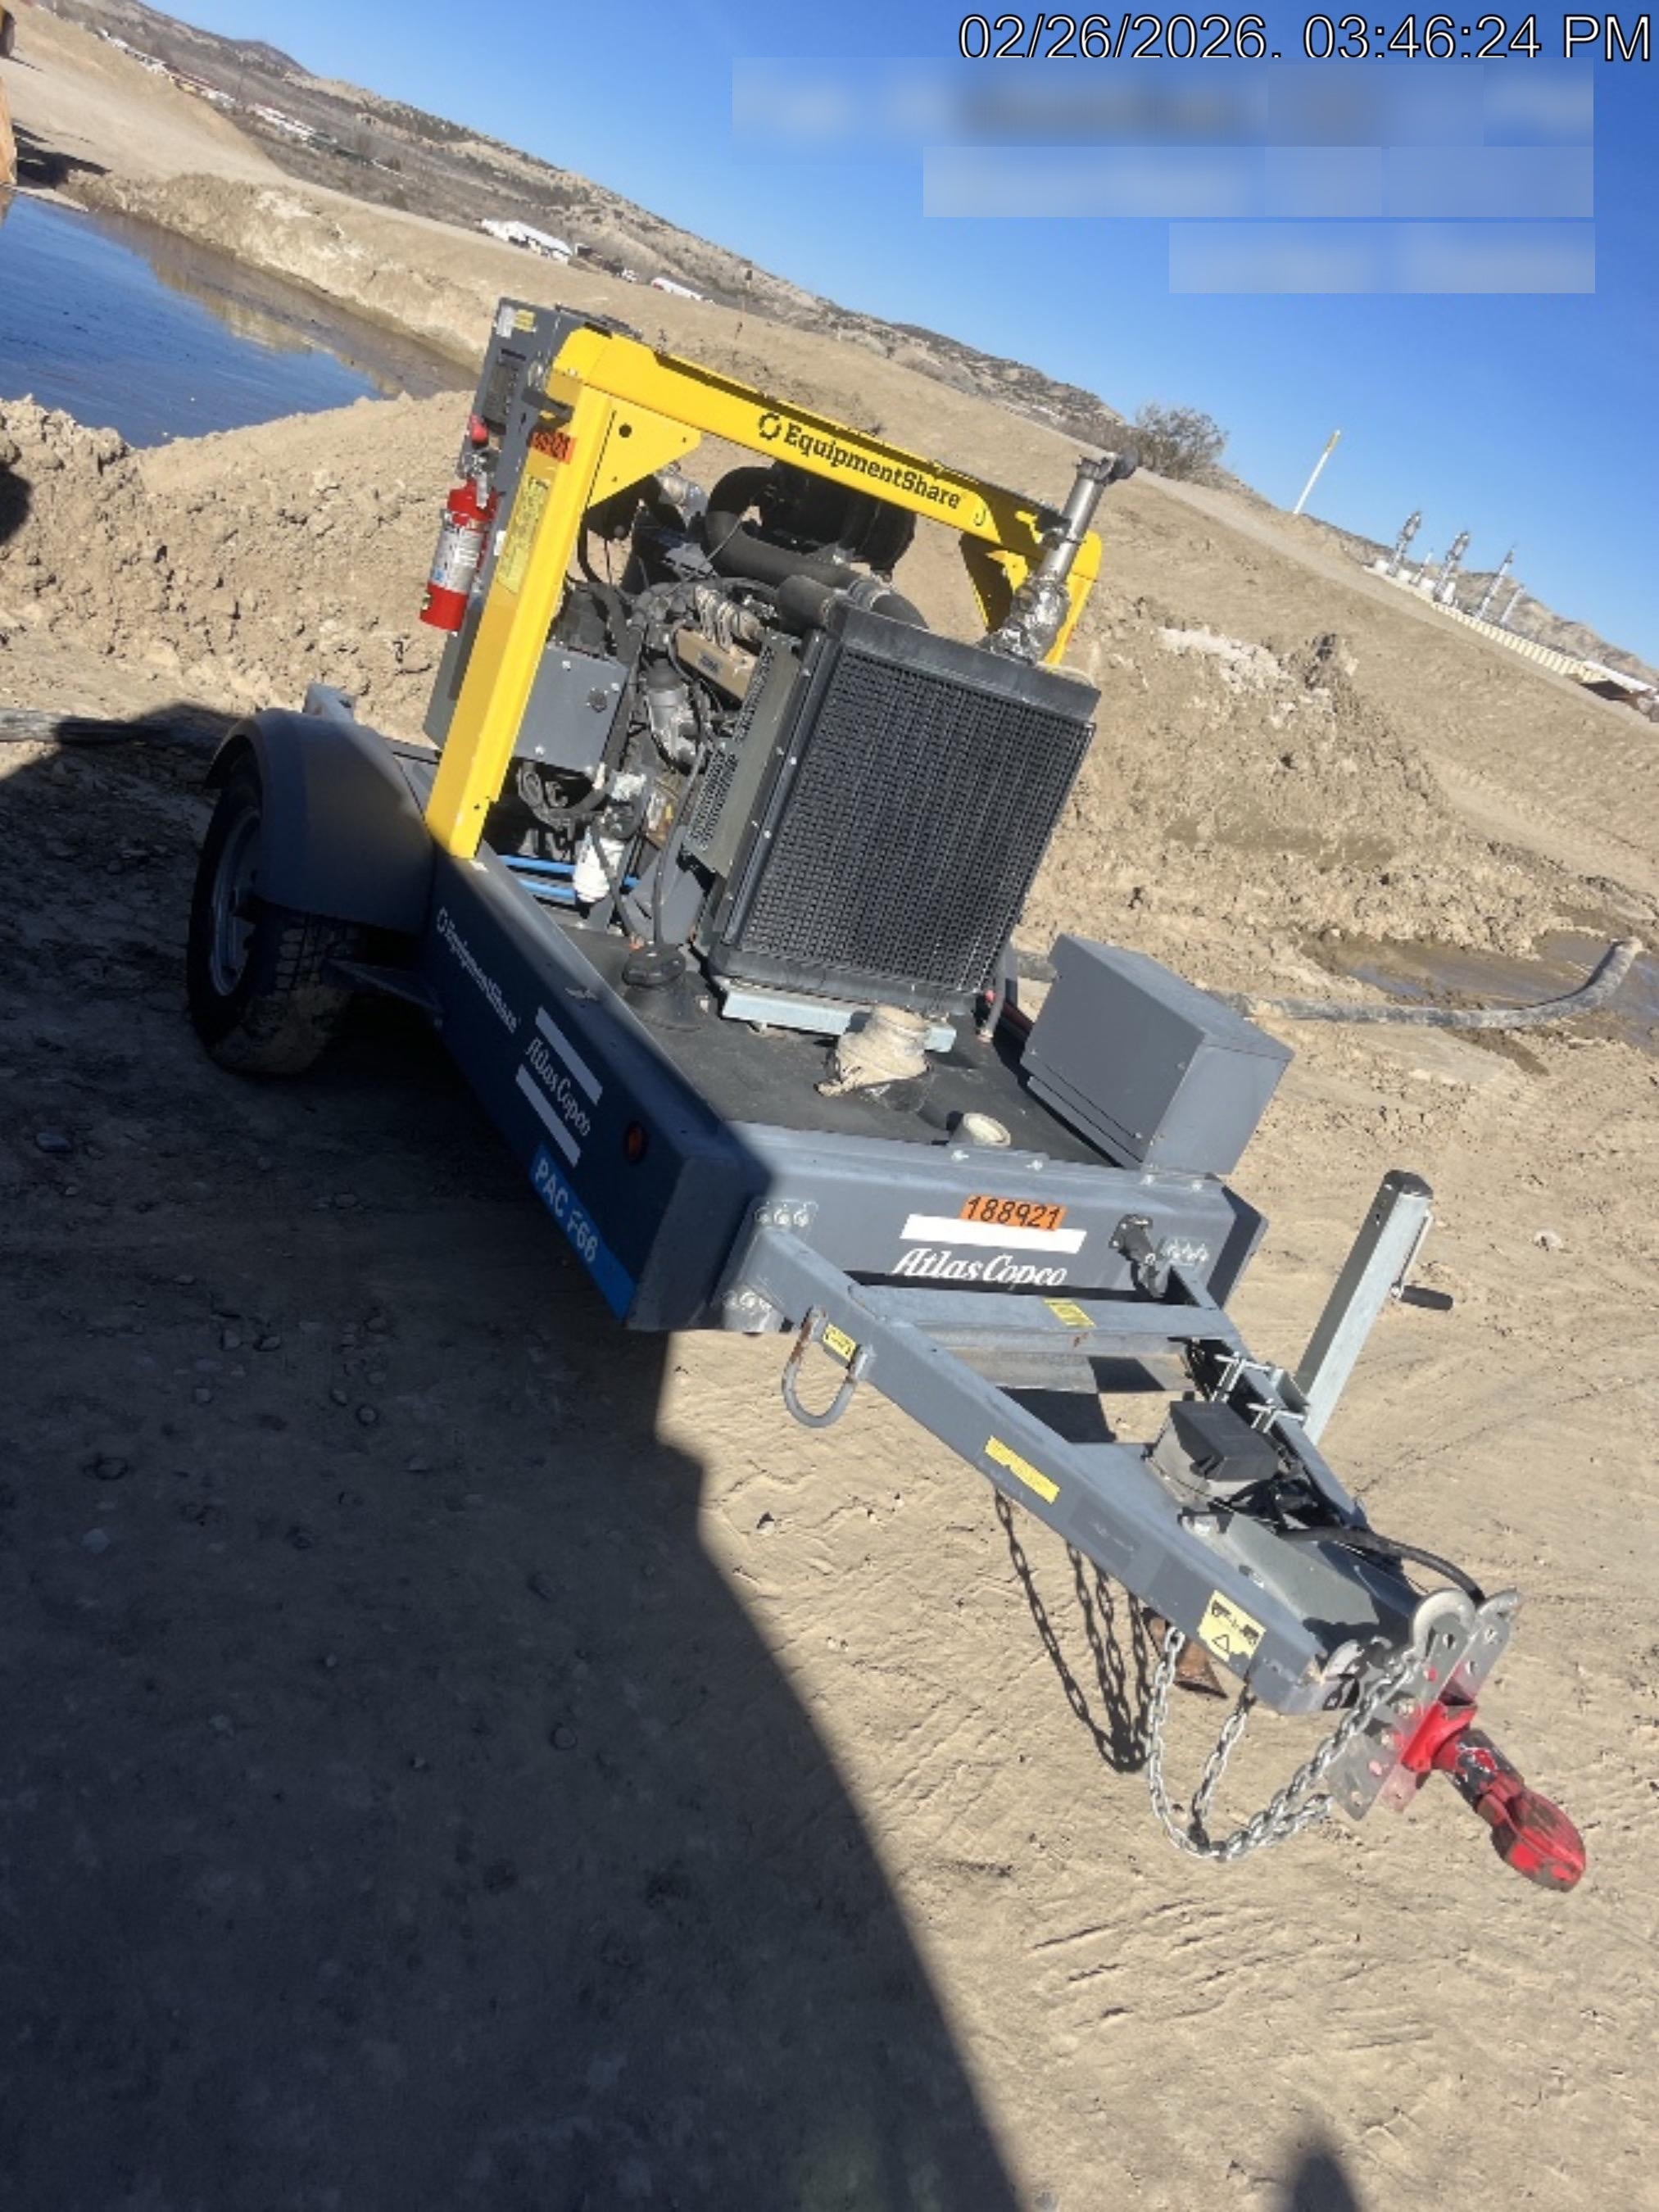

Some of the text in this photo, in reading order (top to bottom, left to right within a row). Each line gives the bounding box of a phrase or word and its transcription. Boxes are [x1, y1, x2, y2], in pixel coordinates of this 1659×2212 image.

[784, 421, 963, 510] EquipmentShare
[534, 1156, 569, 1218] PAC
[966, 1195, 1061, 1231] 188921
[891, 1248, 984, 1281] Atlas
